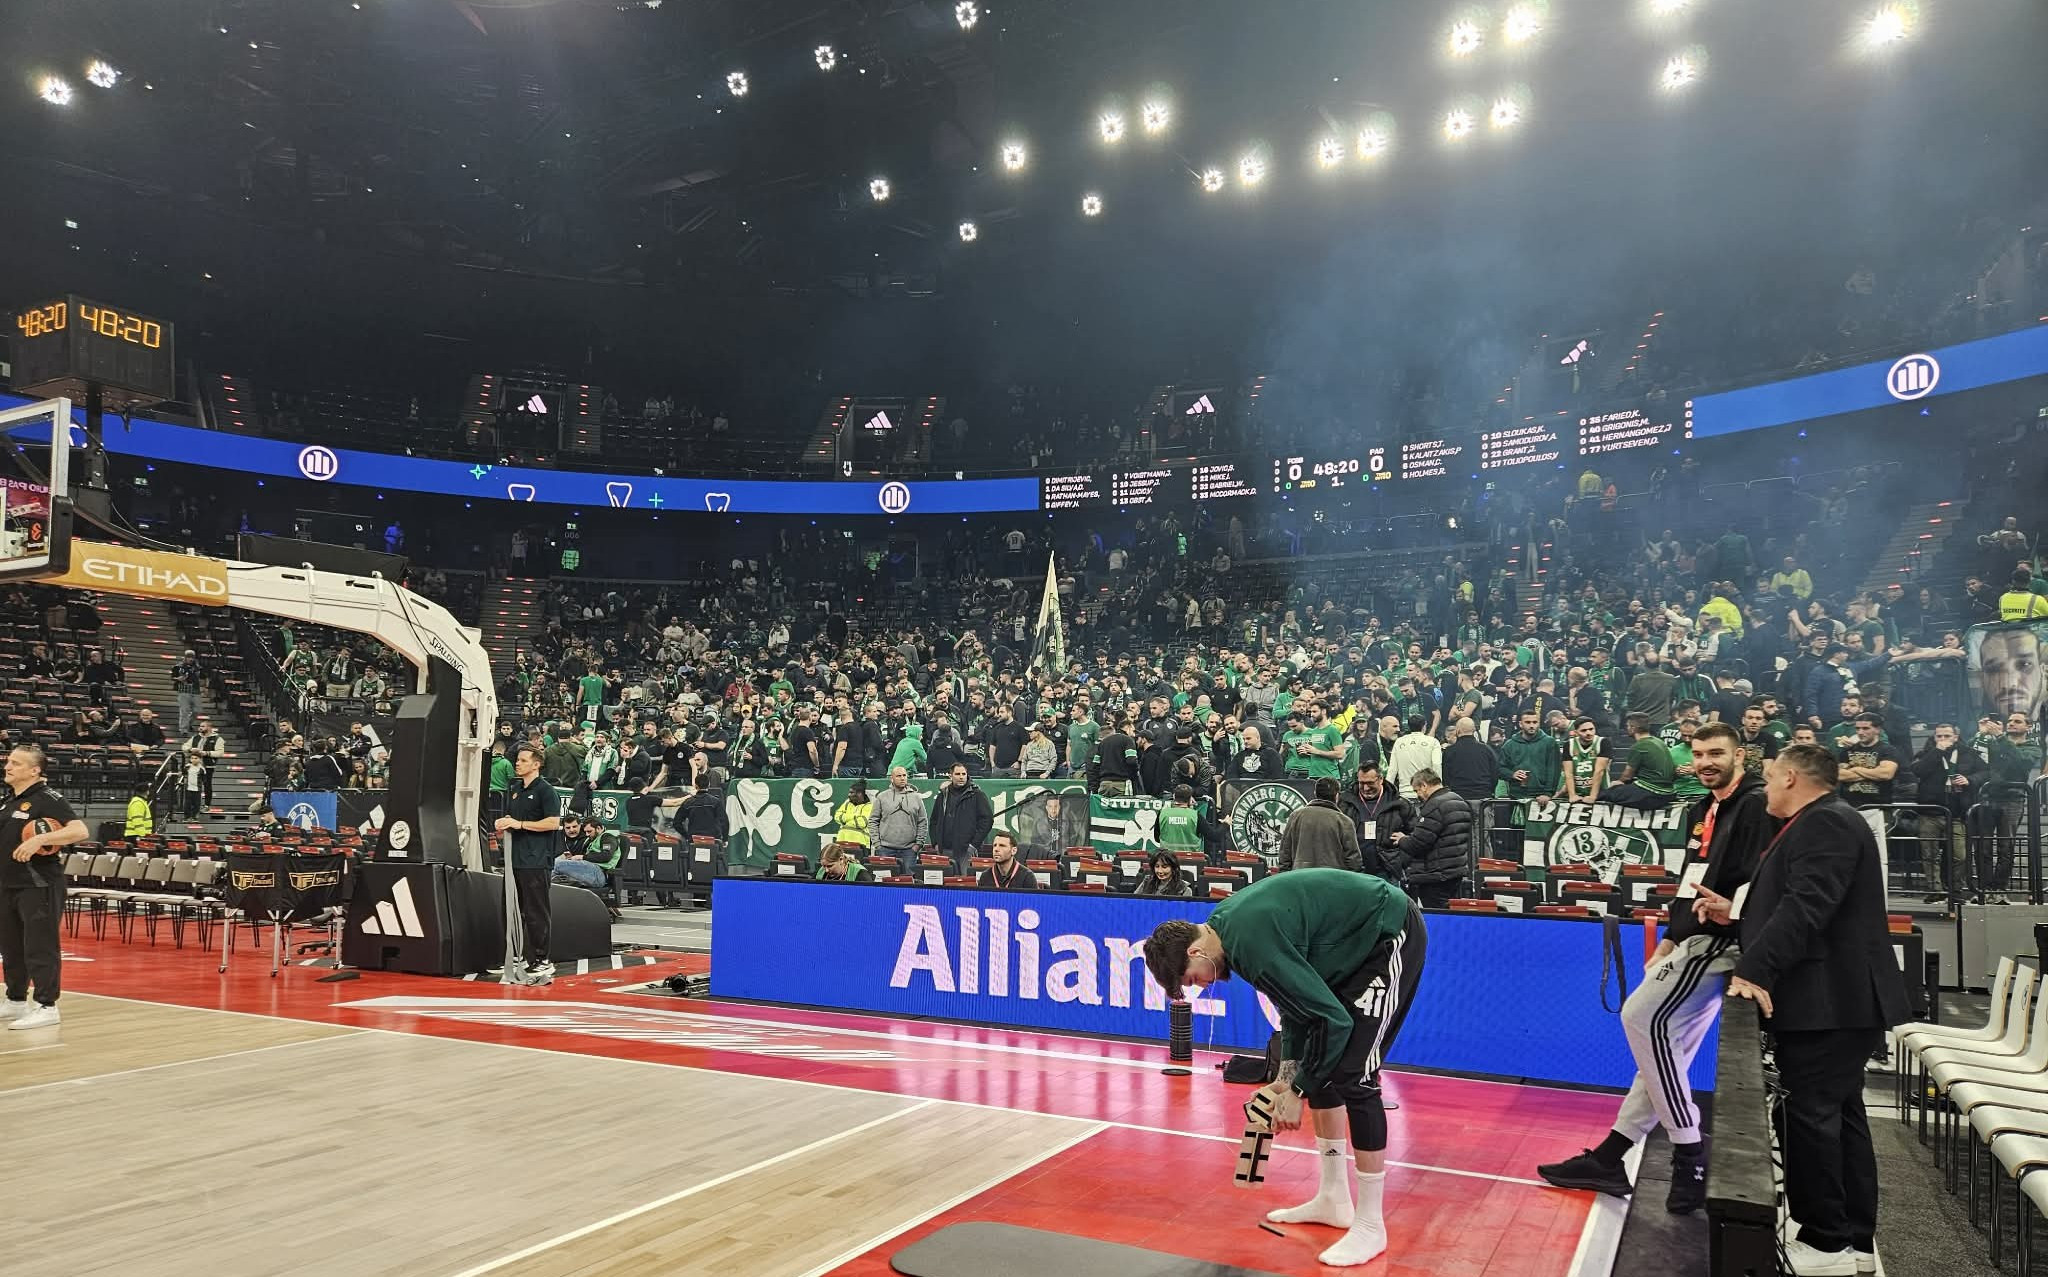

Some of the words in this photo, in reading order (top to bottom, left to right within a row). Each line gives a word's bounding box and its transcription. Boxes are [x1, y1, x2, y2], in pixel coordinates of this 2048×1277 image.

[17, 303, 66, 337] 48:20
[80, 304, 161, 348] 48:20
[1289, 464, 1302, 480] 0
[1314, 459, 1359, 476] 48:20
[1370, 456, 1383, 472] 0
[1331, 476, 1344, 487] 1.
[82, 558, 226, 596] ETIHAD
[430, 636, 465, 672] SPALDING
[1576, 761, 1592, 772] 25
[1100, 797, 1173, 809] STUTTGA
[1280, 790, 1305, 810] GAT
[1169, 816, 1188, 825] MEDIA
[1571, 831, 1595, 855] 13
[1354, 988, 1386, 1017] 41
